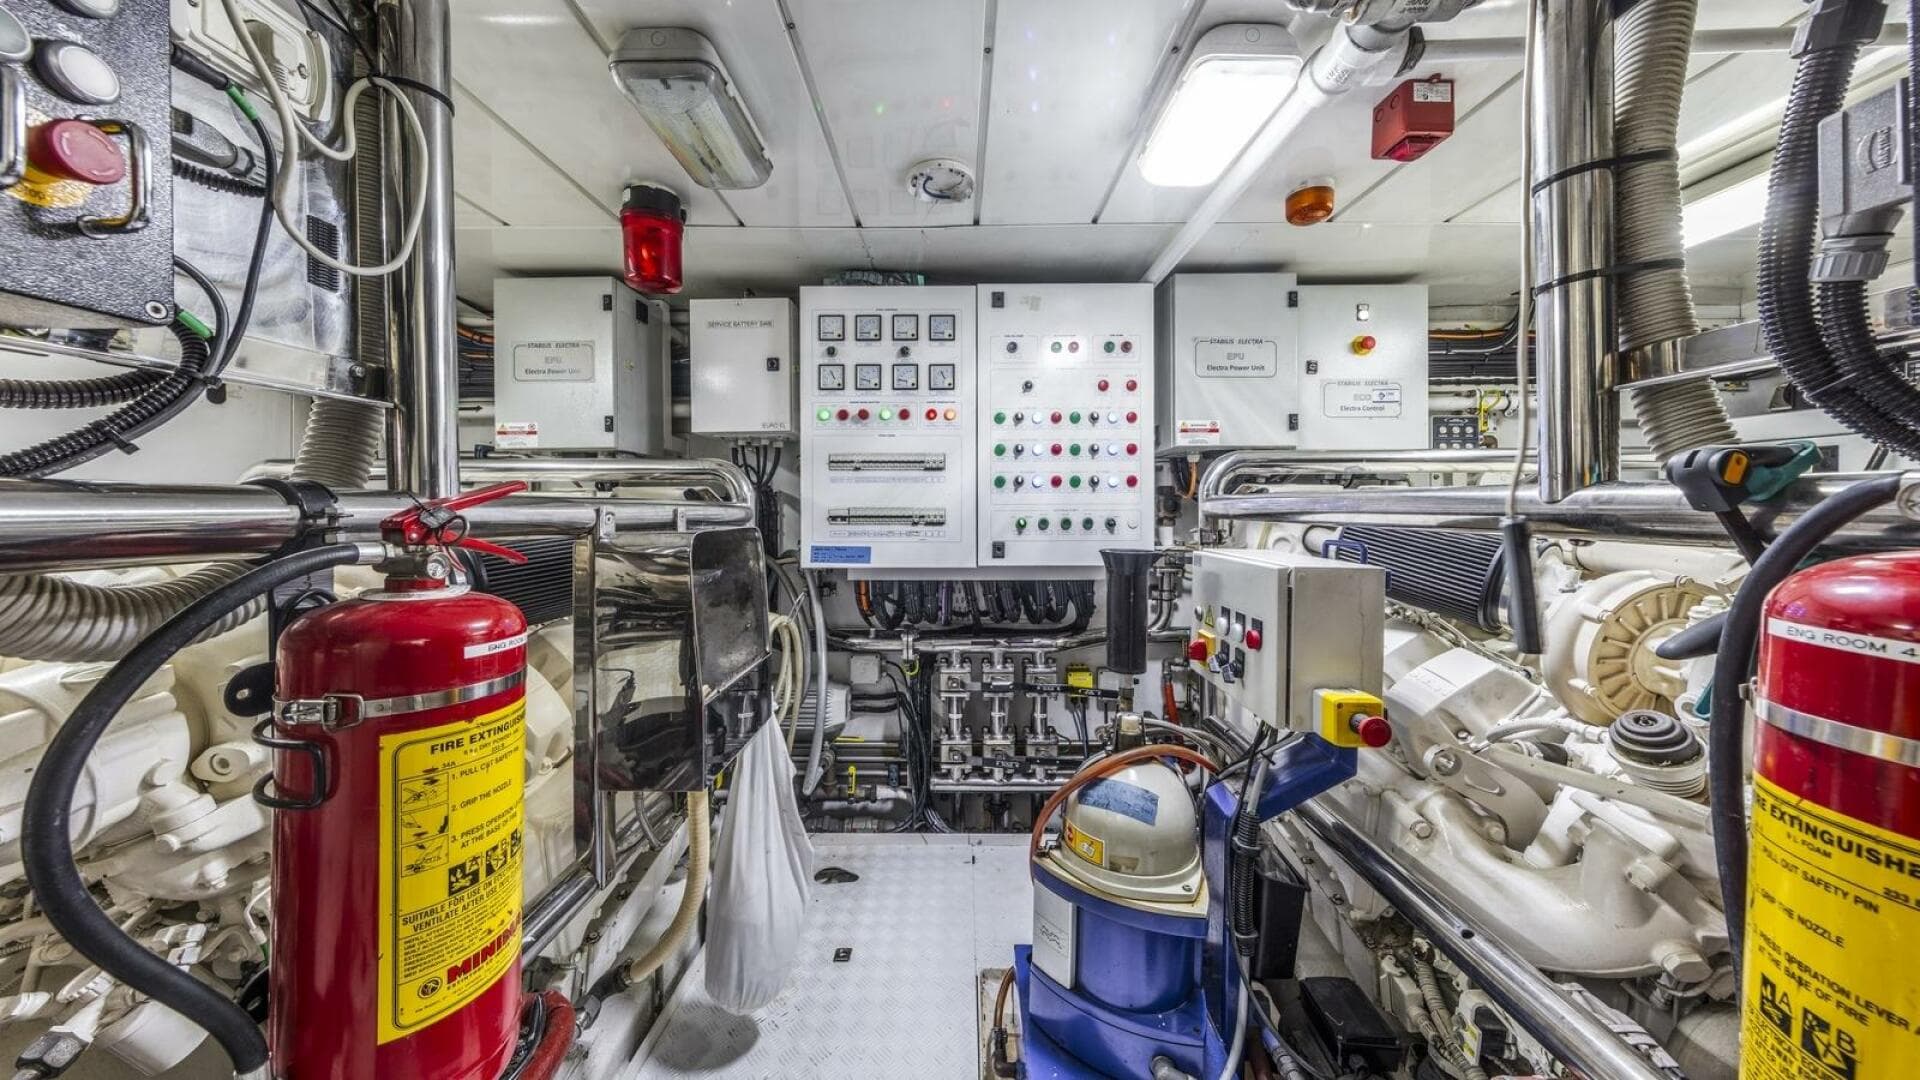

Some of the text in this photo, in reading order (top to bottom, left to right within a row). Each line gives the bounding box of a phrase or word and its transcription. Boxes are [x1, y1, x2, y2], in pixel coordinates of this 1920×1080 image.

[1206, 364, 1229, 372] Electra
[1251, 364, 1265, 372] Unit
[1786, 625, 1917, 657] ENG ROOM 4
[430, 737, 464, 755] FIRE
[460, 766, 478, 777] PULL
[460, 796, 478, 809] GRIP
[479, 790, 492, 800] THE
[493, 778, 512, 793] NOZZLE
[460, 822, 484, 839] PRESS
[461, 839, 470, 849] AT
[471, 833, 484, 844] THE
[486, 822, 501, 837] BASE
[1801, 839, 1832, 859] FOAM
[1780, 858, 1799, 875] OUT
[1801, 869, 1850, 900] SAFETY
[1853, 894, 1880, 914] PIN
[402, 904, 445, 926] SUITABLE
[448, 896, 465, 908] FOR
[467, 886, 481, 899] USE
[483, 879, 493, 890] ON
[413, 906, 458, 933] VENTILATE
[461, 895, 485, 913] AFTER
[486, 885, 498, 898] USE
[1797, 914, 1845, 949] NOZZLE
[1783, 951, 1852, 1000] OPERATION
[1854, 995, 1910, 1032] LEVER
[1783, 966, 1812, 992] BASE
[1814, 987, 1833, 1003] OF
[1835, 1000, 1870, 1027] FIRE
[1836, 1028, 1857, 1055] B
